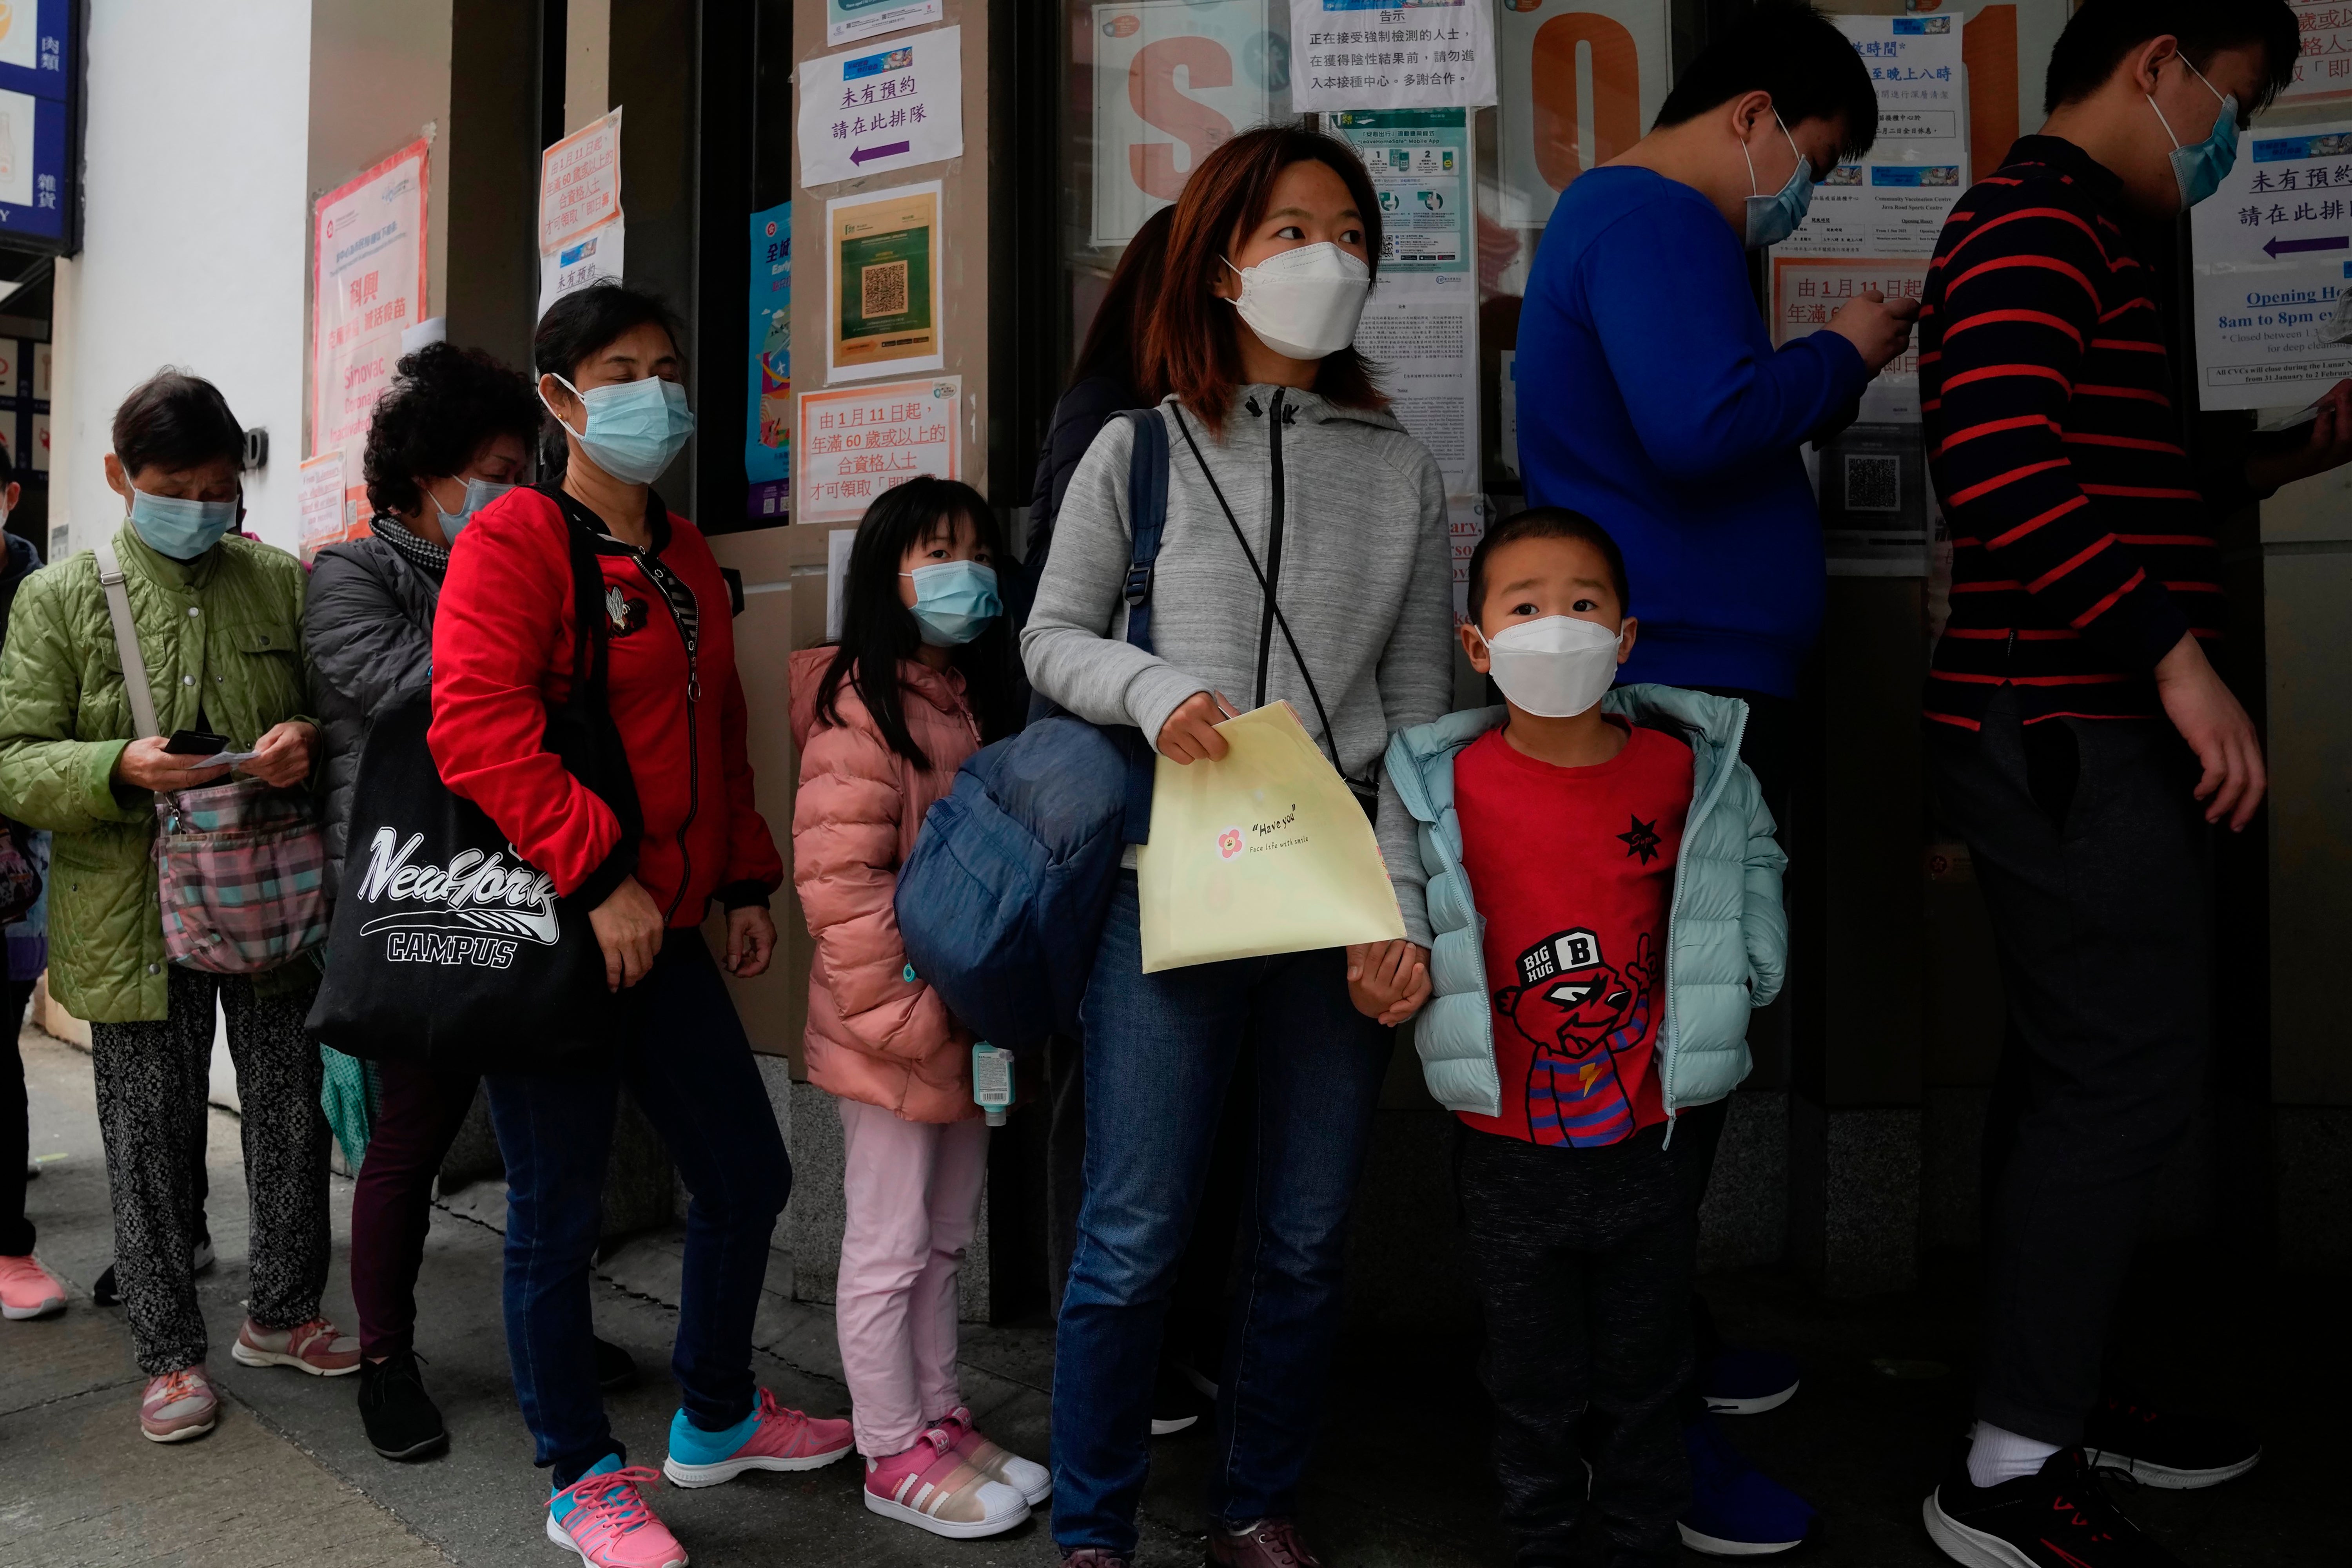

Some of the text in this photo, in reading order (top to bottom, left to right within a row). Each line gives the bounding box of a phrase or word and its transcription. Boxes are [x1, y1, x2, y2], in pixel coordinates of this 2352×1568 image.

[1379, 10, 1405, 22] 告示
[1309, 29, 1469, 45] 正在接受強制檢測的人士，
[2302, 35, 2352, 56] 格人
[42, 36, 59, 72] 肉類
[1310, 49, 1474, 67] 在獲得陰性結果前，請勿進
[1311, 72, 1466, 89] 入本接種中心。多謝合作。
[1871, 66, 1952, 82] 至晚上八時
[841, 76, 915, 107] 未有預約
[831, 103, 927, 140] 請在此排隊
[2238, 200, 2352, 227] 請在此排
[558, 262, 595, 290] 未有預約
[2247, 290, 2316, 306] Opening
[2219, 316, 2252, 328] 8am
[2258, 315, 2273, 325] to
[2279, 312, 2313, 326] 8pm
[2264, 332, 2302, 340] between
[2284, 343, 2305, 353] deep
[344, 357, 385, 390] Sinovac
[812, 424, 946, 452] 年滿60歲或以上的
[838, 451, 917, 475] 合資格人士
[1265, 841, 1278, 850] life
[1280, 838, 1293, 848] with
[1294, 835, 1309, 845] smile
[358, 827, 450, 903] New
[387, 932, 518, 969] CAMPUS
[1523, 945, 1550, 971] BIG
[1568, 937, 1591, 966] B
[1527, 961, 1554, 982] HUG
